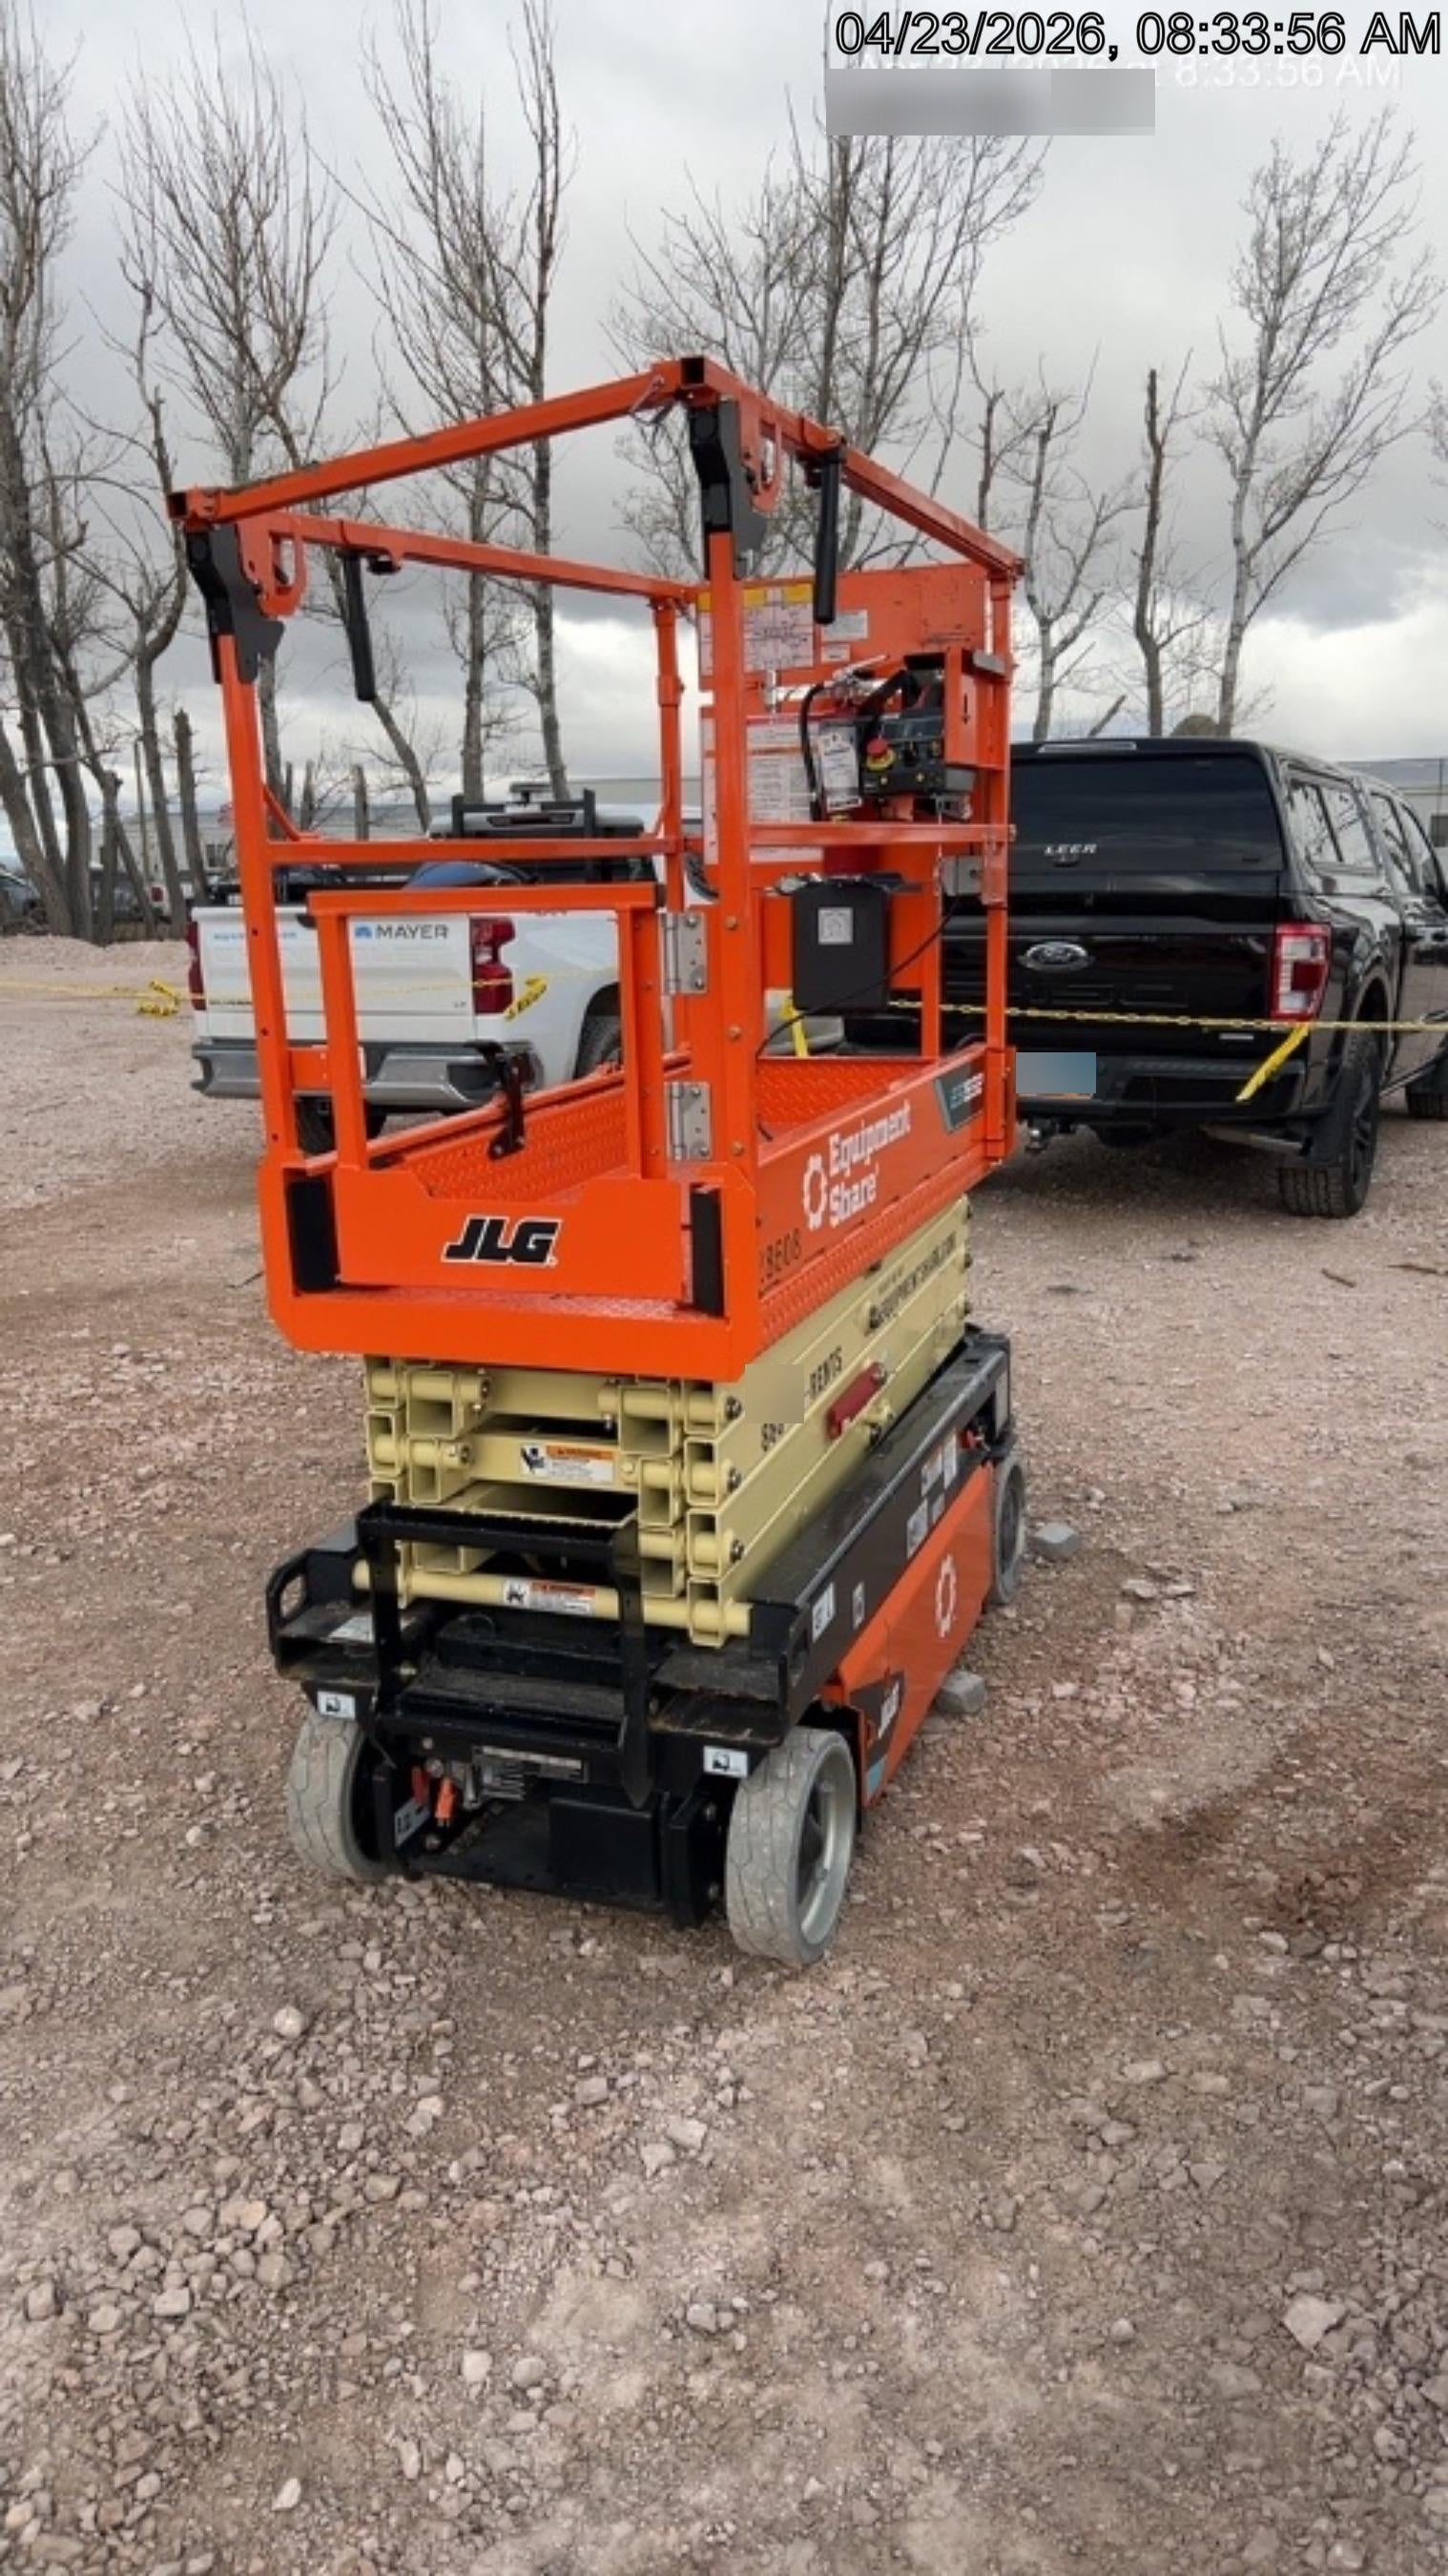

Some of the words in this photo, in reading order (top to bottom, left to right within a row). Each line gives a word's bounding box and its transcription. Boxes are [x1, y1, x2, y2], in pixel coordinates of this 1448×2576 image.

[376, 924, 448, 940] MAYER
[828, 1099, 911, 1177] Equipment
[828, 1173, 879, 1229] Share
[441, 1213, 562, 1267] JLG
